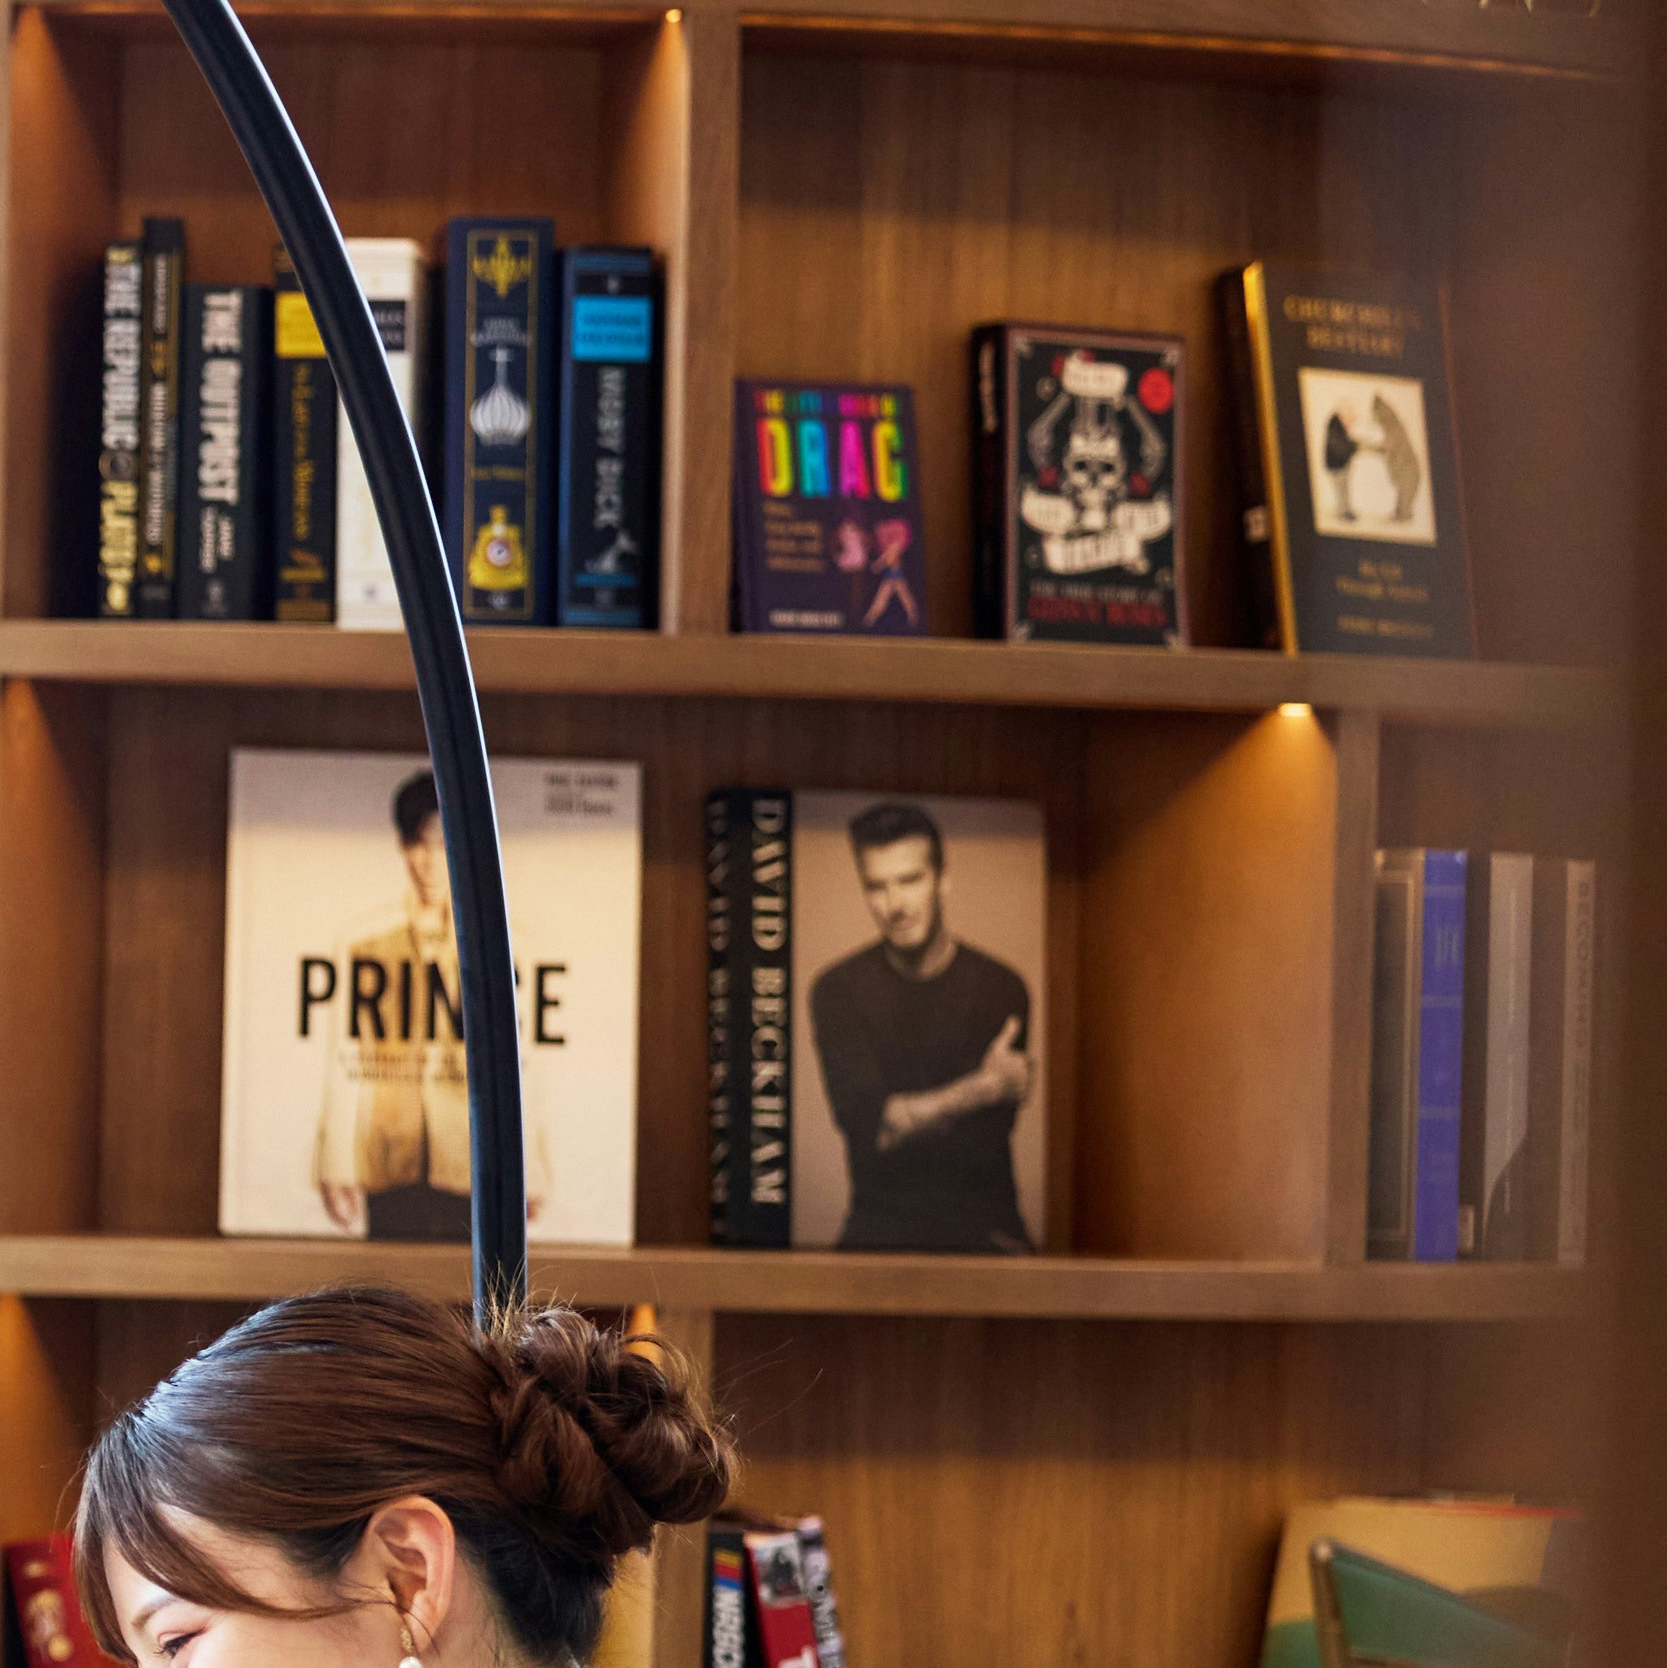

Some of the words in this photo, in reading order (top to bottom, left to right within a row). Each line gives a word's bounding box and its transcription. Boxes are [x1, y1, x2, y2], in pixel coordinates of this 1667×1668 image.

[201, 288, 244, 353] THE
[198, 358, 242, 506] OUTPOST
[597, 366, 625, 450] MOBY
[593, 456, 623, 529] DICK
[755, 418, 909, 503] DRAG
[750, 799, 788, 952] DAVID
[298, 955, 567, 1045] PRINE
[750, 966, 788, 1205] BECKHAM
